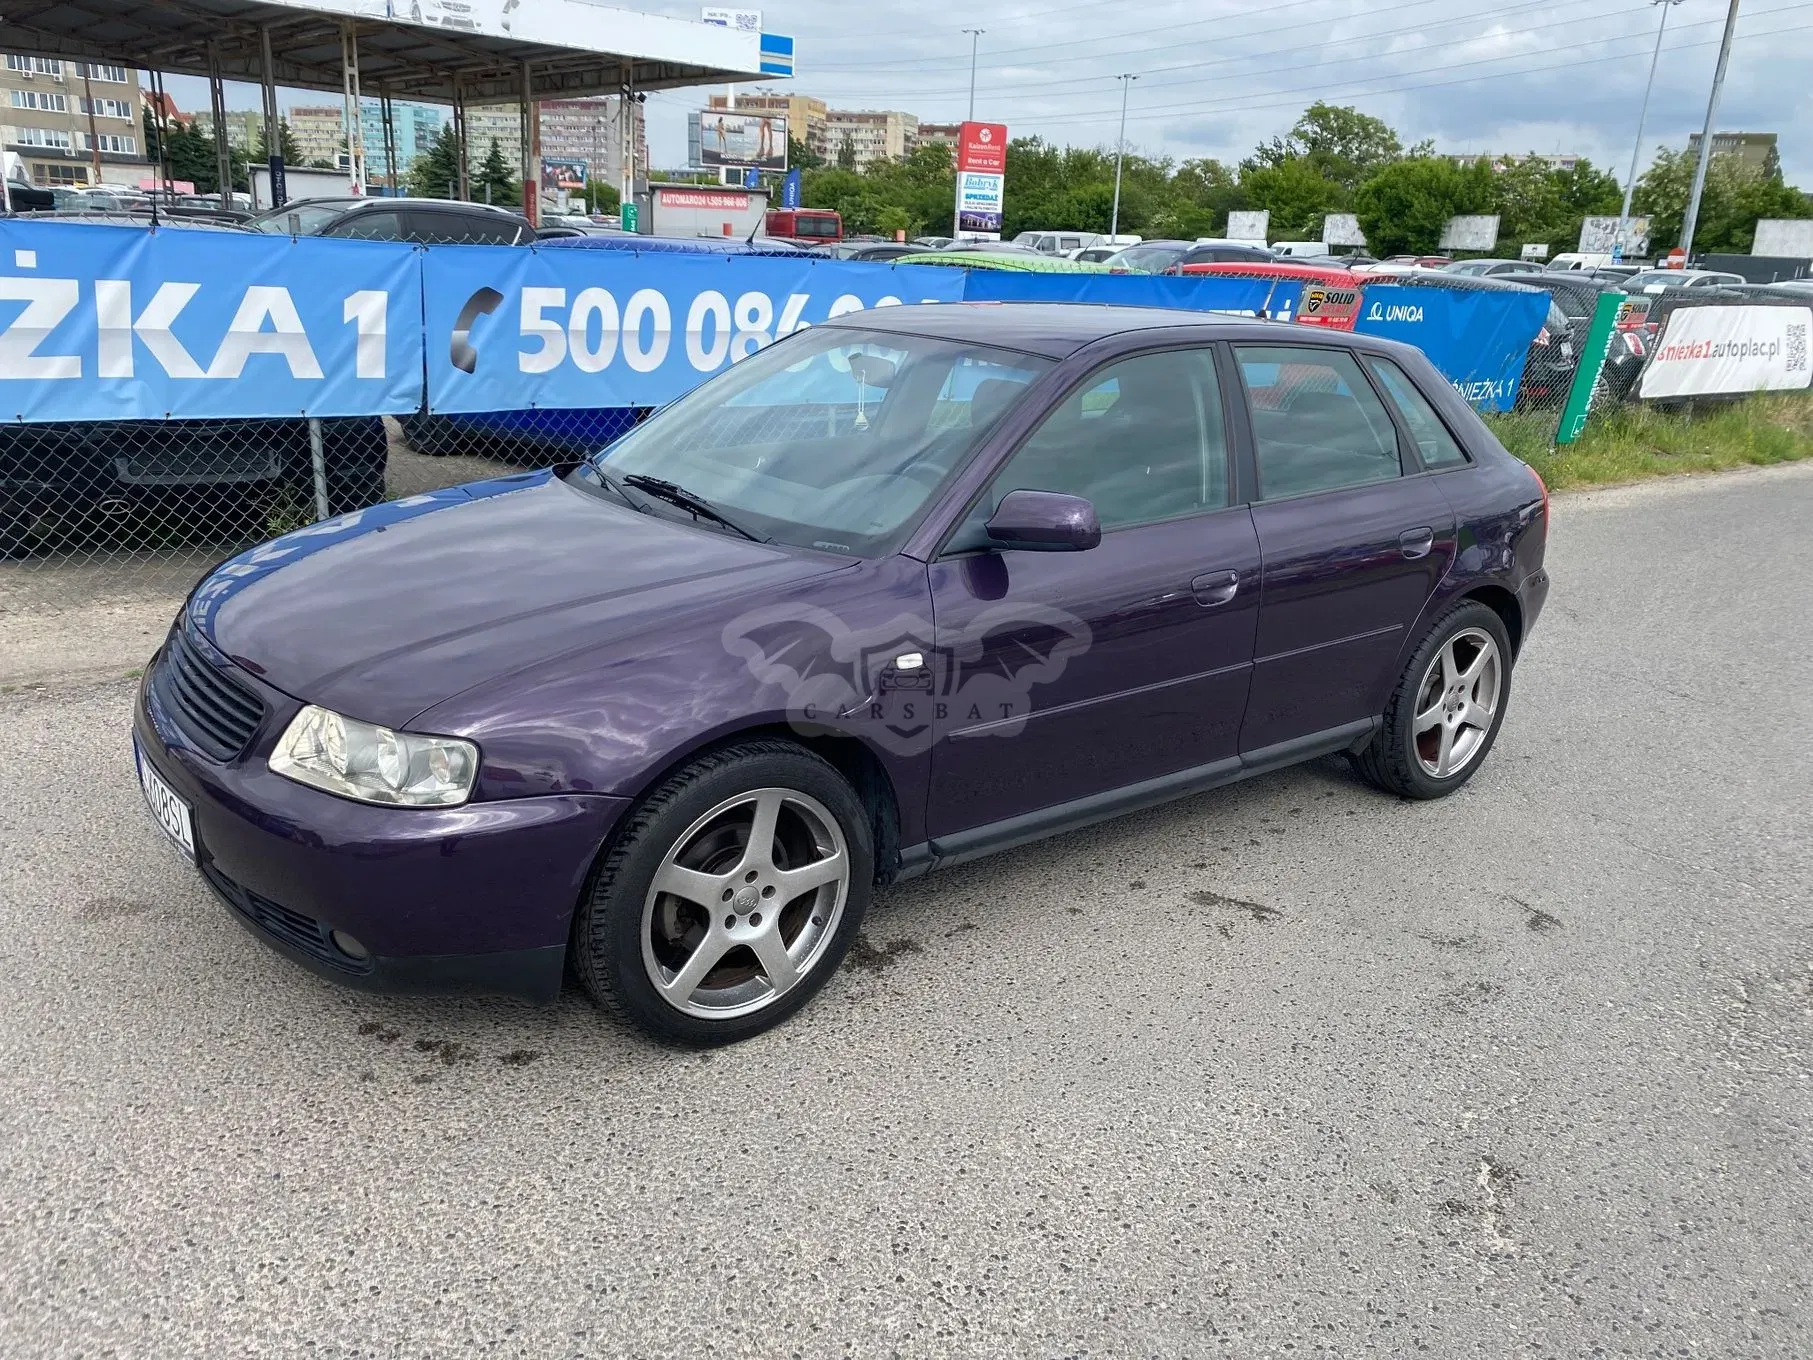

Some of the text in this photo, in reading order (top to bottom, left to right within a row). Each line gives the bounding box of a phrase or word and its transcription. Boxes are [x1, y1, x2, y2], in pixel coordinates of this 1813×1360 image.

[967, 157, 982, 165] Rent
[1323, 291, 1355, 304] SOLID
[1386, 305, 1424, 322] UNIQA
[343, 290, 388, 379] 1
[518, 287, 671, 373] 500
[1507, 377, 1515, 397] 1
